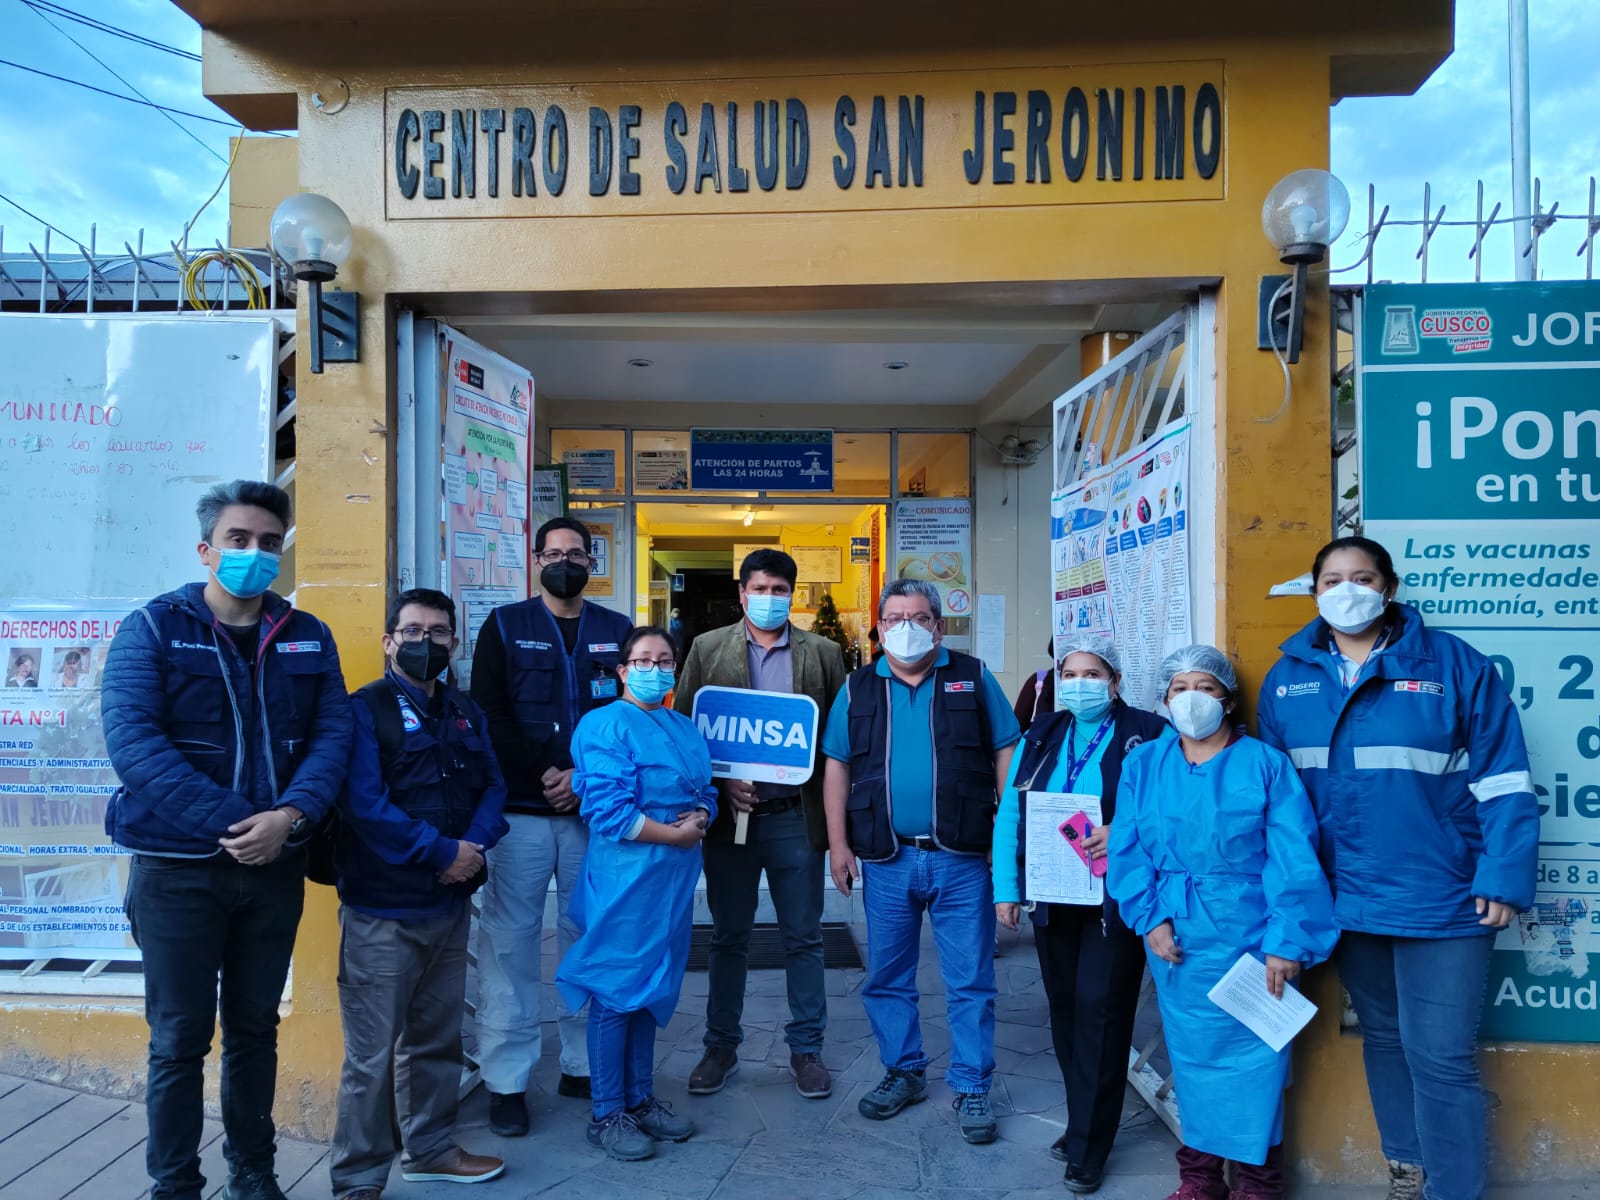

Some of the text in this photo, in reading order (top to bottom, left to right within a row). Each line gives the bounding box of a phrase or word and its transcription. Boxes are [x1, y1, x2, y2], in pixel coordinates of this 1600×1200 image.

[395, 82, 1222, 200] CENTRO DE SALUD SAN JERONIMO
[1421, 315, 1490, 333] CUSCO
[1416, 396, 1600, 468] ¡Pon
[748, 459, 761, 468] DE
[763, 459, 802, 468] PARTOS
[713, 469, 784, 478] LAS 24 HORAS
[1476, 467, 1600, 503] en tu
[915, 507, 970, 515] COMUNICADO
[1404, 538, 1591, 559] Las vacunas
[1404, 566, 1600, 593] enfermedade
[1554, 597, 1600, 615] ent
[1, 621, 77, 639] DERECHOS
[81, 621, 100, 639] DE
[1, 710, 24, 726] TA
[58, 710, 66, 726] 1
[698, 713, 808, 750] MINSA
[19, 741, 33, 749] RED
[39, 759, 44, 767] Y
[46, 759, 112, 768] ADMINISTRATIVO
[51, 785, 74, 793] TRATO
[30, 846, 56, 854] HORAS
[1567, 866, 1580, 885] 8
[1586, 871, 1599, 885] a
[10, 906, 48, 914] PERSONAL
[51, 906, 96, 914] NOMBRADO
[98, 906, 103, 914] Y
[7, 923, 16, 931] DE
[33, 923, 107, 931] ESTABLECIMIENTOS
